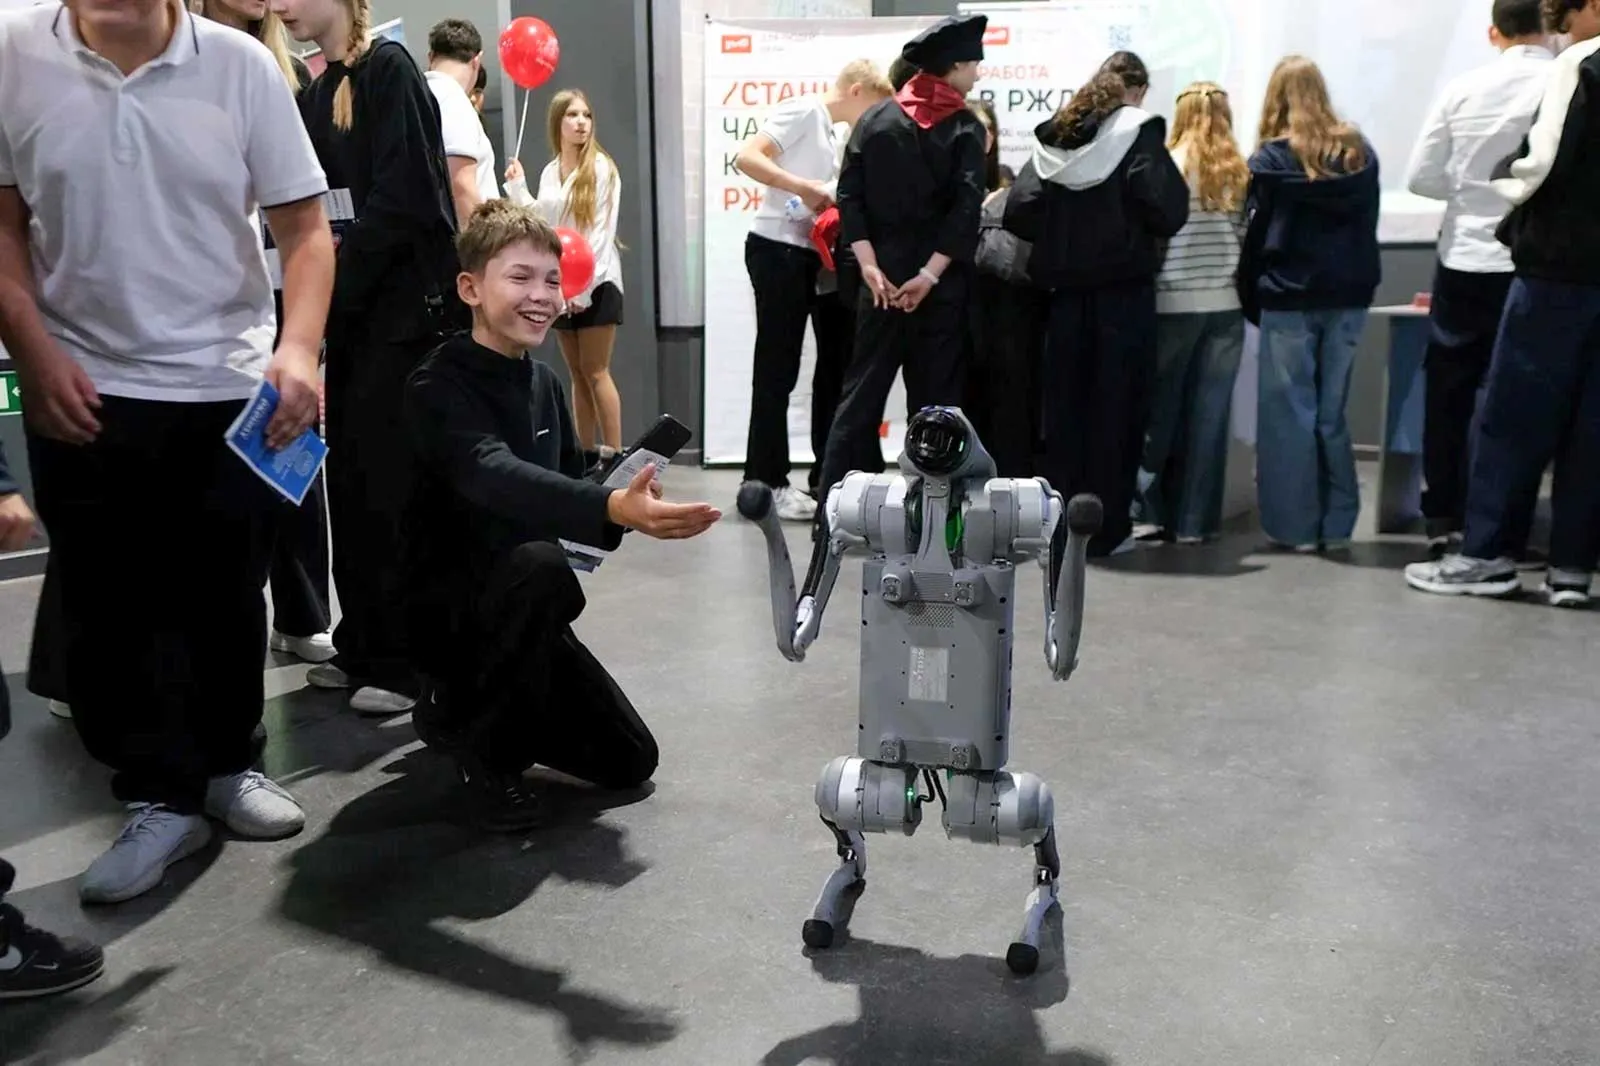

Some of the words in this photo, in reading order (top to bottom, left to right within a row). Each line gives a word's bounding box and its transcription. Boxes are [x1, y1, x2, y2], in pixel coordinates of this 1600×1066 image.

[979, 64, 1049, 80] РАБОТА
[722, 81, 828, 106] /СТАН
[723, 116, 769, 141] ЧА
[723, 152, 741, 176] К
[723, 187, 763, 211] РЖ
